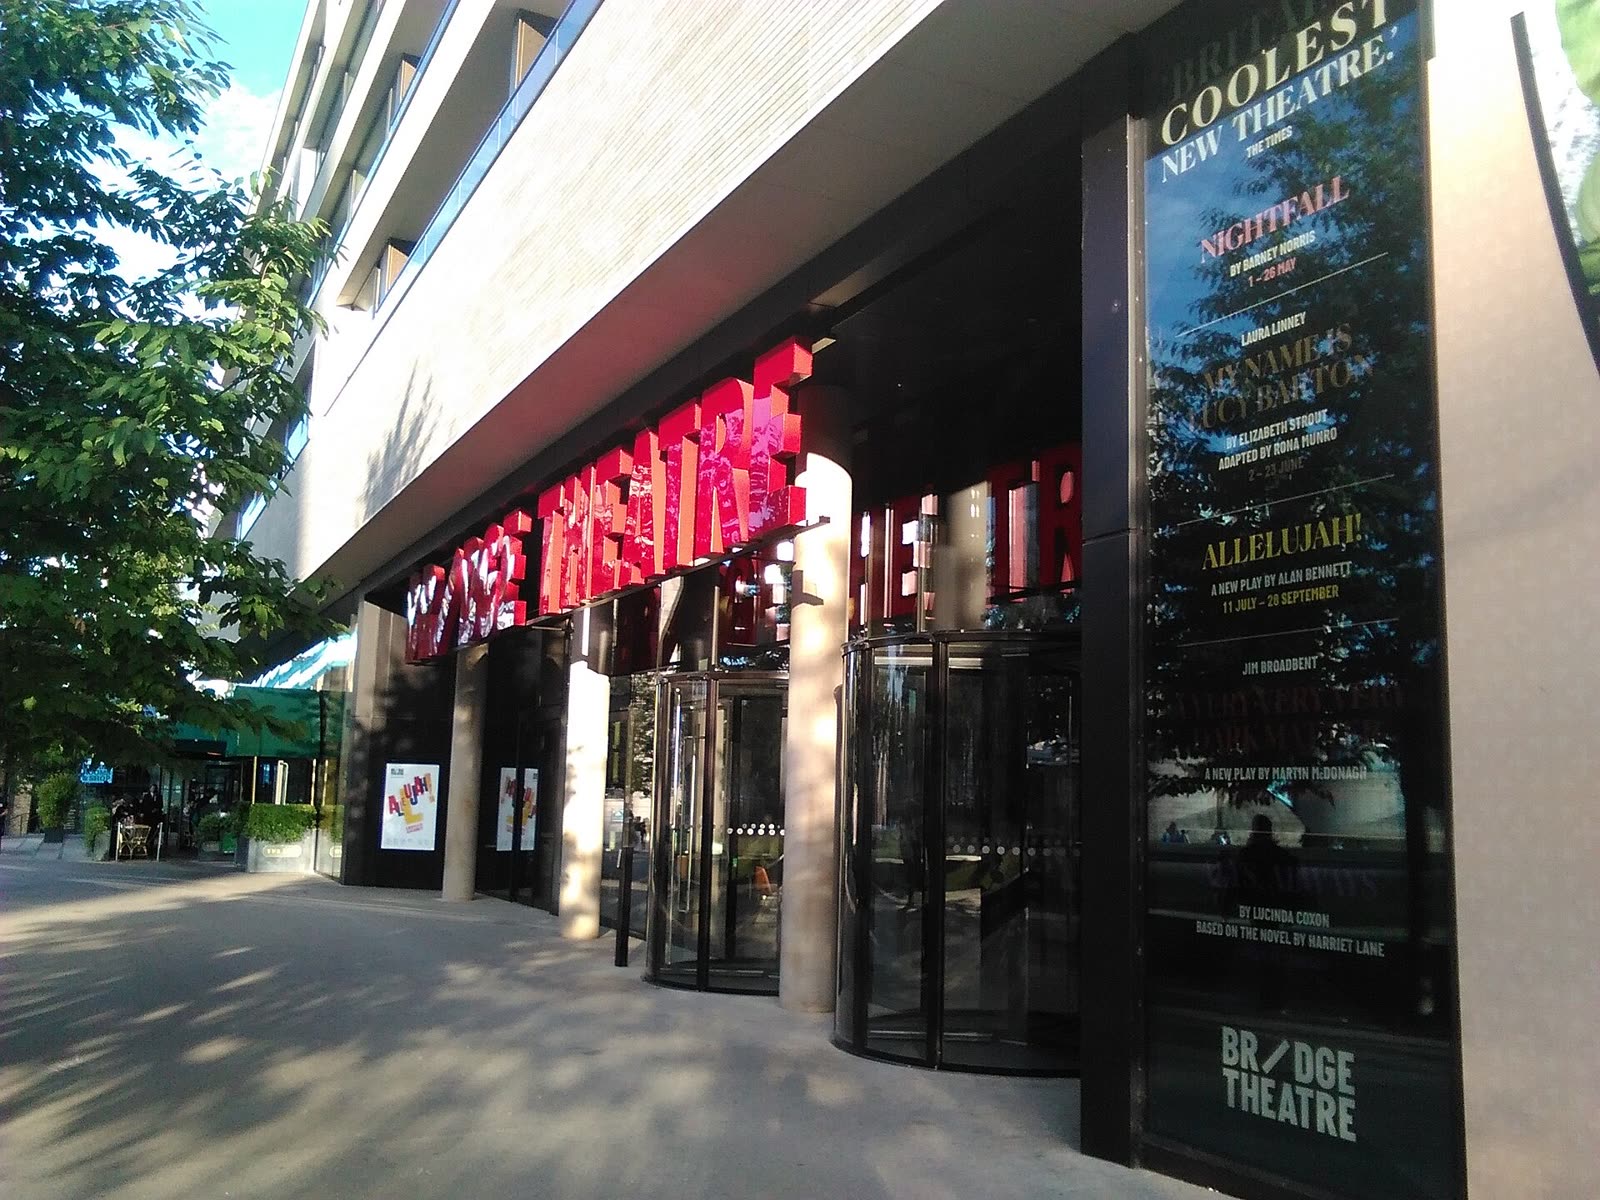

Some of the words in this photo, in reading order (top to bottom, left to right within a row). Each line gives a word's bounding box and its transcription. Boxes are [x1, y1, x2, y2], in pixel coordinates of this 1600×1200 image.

[1161, 0, 1388, 146] COOLEST
[1161, 125, 1223, 183] NEW
[1246, 140, 1264, 158] THE
[1265, 125, 1293, 148] TIMES
[1201, 175, 1350, 264] NIGHTFALL
[1230, 263, 1241, 277] BY
[1243, 246, 1278, 272] BARNEY
[1280, 230, 1316, 257] NORRIS
[1248, 275, 1254, 287] 1
[1263, 267, 1276, 282] 26
[1277, 257, 1297, 276] MAY
[1241, 325, 1271, 346] LAURA
[1272, 311, 1306, 336] LINNEY
[1245, 334, 1319, 379] NAME
[1226, 436, 1238, 449] BY
[1240, 420, 1288, 446] ELIZABETH
[1289, 409, 1328, 431] STROUT
[1218, 449, 1258, 470] ADAPTED
[1260, 445, 1272, 460] BY
[1273, 438, 1300, 455] RONA
[1301, 427, 1338, 448] MUNRO
[1279, 456, 1304, 474] JUNE
[537, 336, 814, 617] THEATRE
[1202, 513, 1362, 570] ALLELUJAH!
[1211, 584, 1217, 597] A
[1219, 580, 1238, 595] NEW
[1240, 576, 1262, 592] PLAY
[1264, 574, 1276, 588] BY
[1278, 569, 1303, 585] ALAN
[1305, 561, 1352, 581] BENNETT
[1223, 600, 1233, 614] 11
[1235, 597, 1257, 612] JULY
[1281, 584, 1340, 606] SEPTEMBER
[1242, 660, 1259, 676] JIM
[1261, 655, 1319, 673] BROADBENT
[1204, 768, 1211, 781] A
[1212, 767, 1232, 781] NEW
[1234, 767, 1256, 780] PLAY
[1258, 767, 1270, 780] BY
[1272, 767, 1310, 780] MARTIN
[1239, 904, 1250, 919] BY
[1253, 907, 1294, 925] LUCINDA
[1296, 910, 1330, 929] COXON
[1196, 921, 1223, 936] BASED
[1225, 924, 1238, 938] ON
[1240, 926, 1258, 941] THE
[1260, 928, 1291, 946] NOVEL
[1293, 932, 1306, 947] BY
[1308, 934, 1353, 954] HARRIET
[1356, 940, 1385, 958] LANE
[1222, 1067, 1357, 1143] THEATRE
